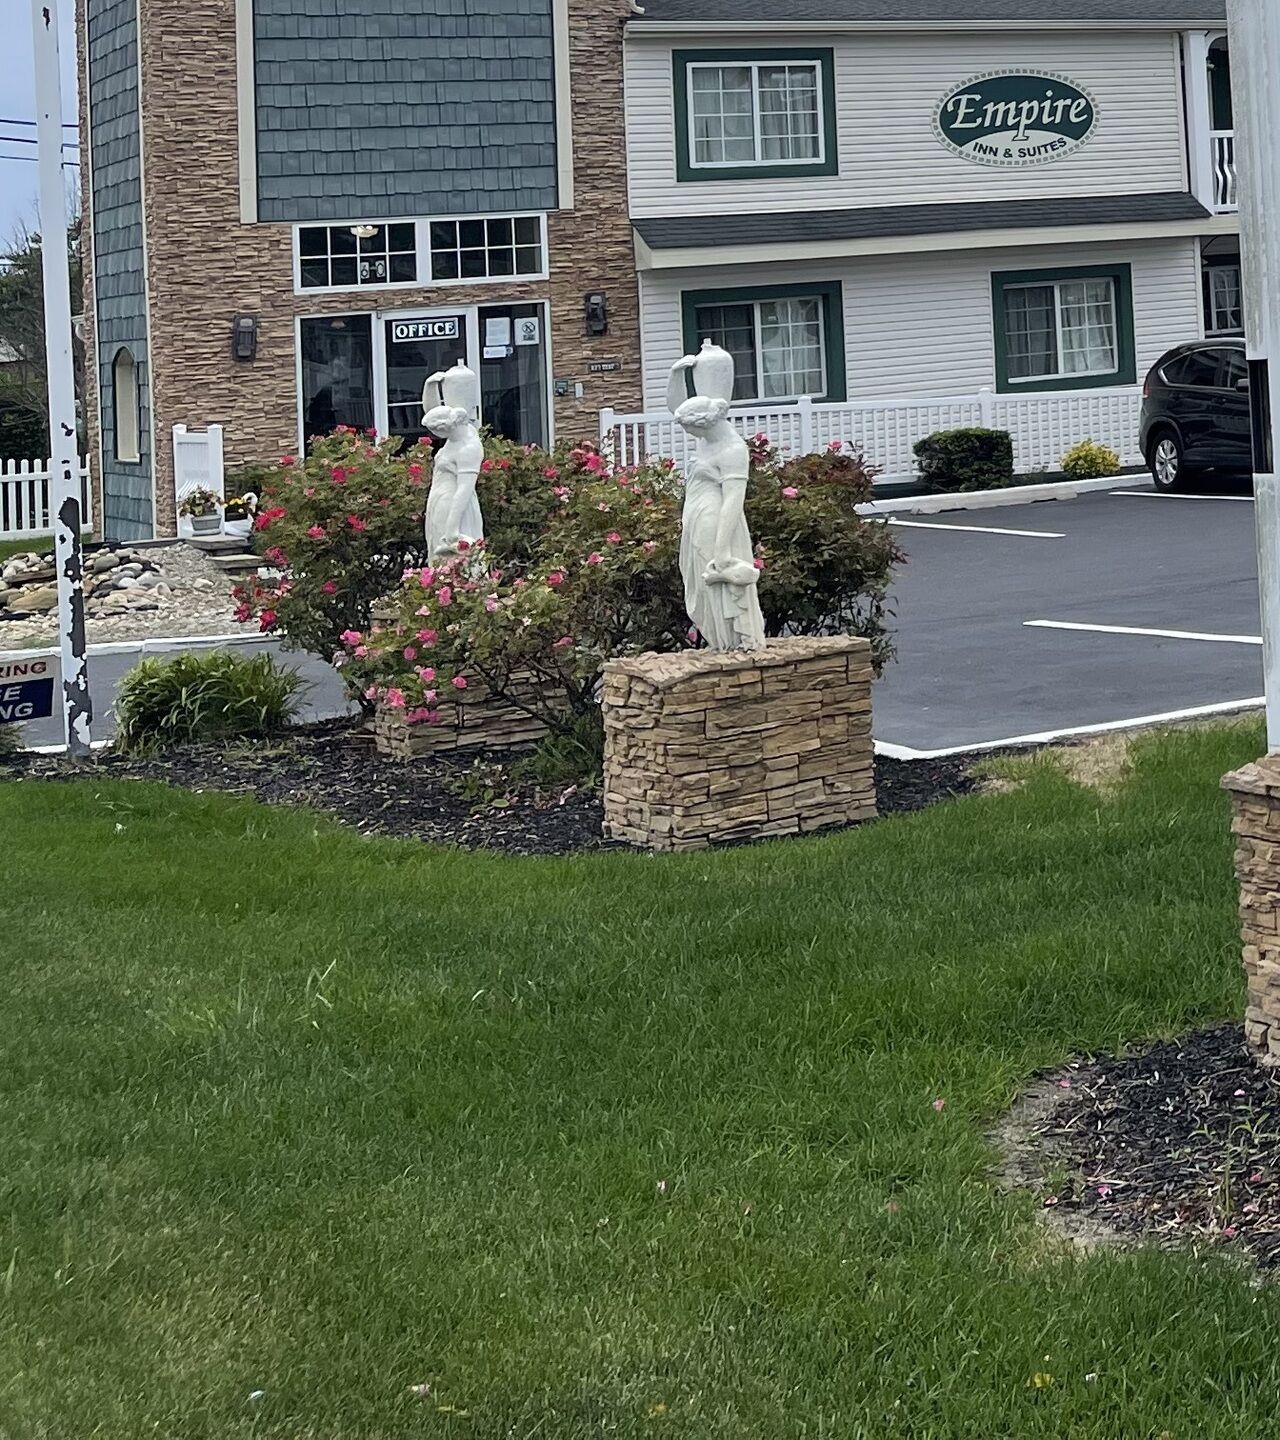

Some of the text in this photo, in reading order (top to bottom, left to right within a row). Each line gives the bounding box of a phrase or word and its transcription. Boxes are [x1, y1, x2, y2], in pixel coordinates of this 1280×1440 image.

[947, 89, 1088, 141] Empire
[973, 137, 1067, 158] INN & SUITES
[396, 322, 456, 338] OFFICE
